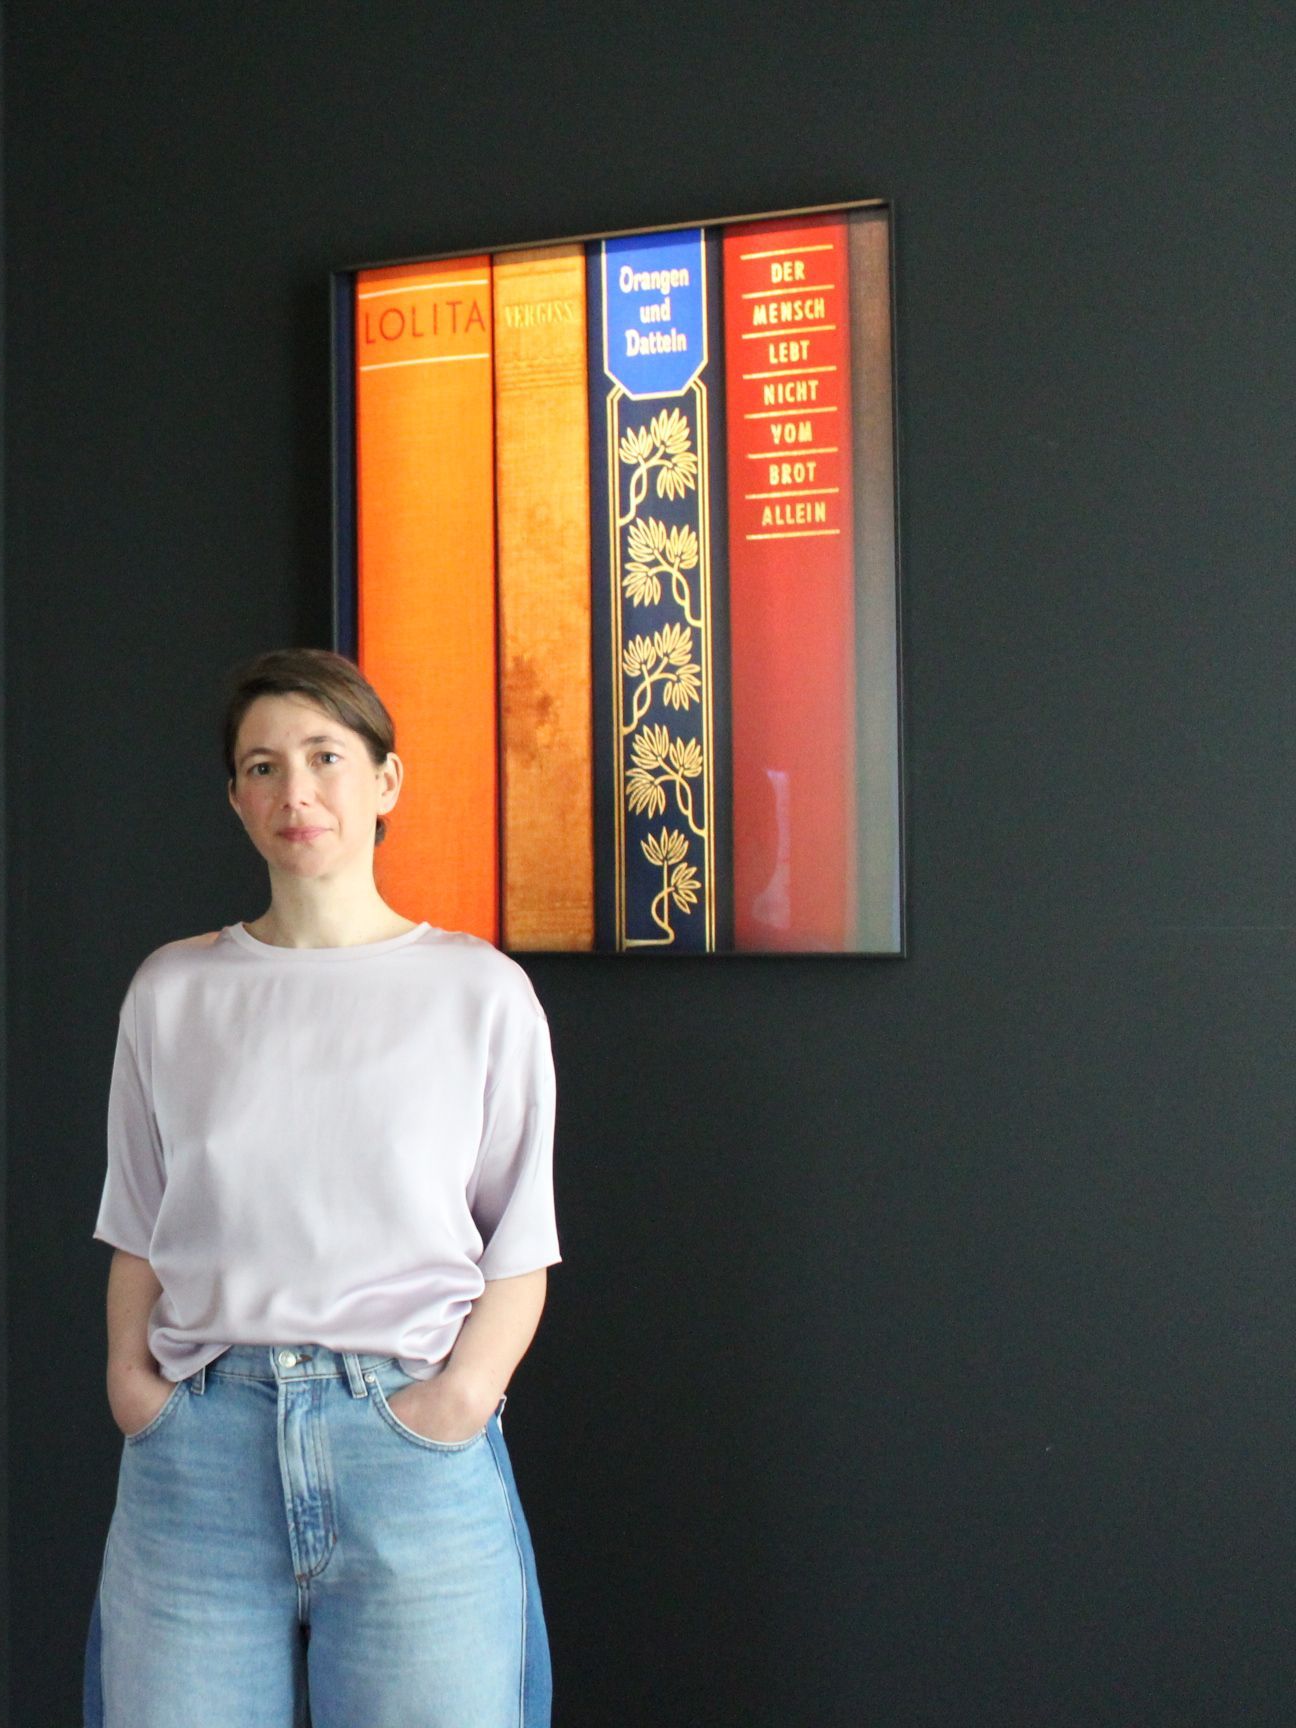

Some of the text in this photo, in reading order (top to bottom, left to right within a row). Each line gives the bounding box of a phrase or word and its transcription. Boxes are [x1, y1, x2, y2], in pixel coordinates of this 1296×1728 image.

[619, 265, 690, 295] Orangen
[770, 260, 805, 284] DER
[365, 300, 486, 345] LOLITA
[503, 300, 575, 328] VERGISS
[639, 297, 671, 324] und
[752, 297, 825, 326] MENSCH
[624, 328, 687, 357] Datteln
[768, 340, 810, 365] LEBT
[763, 380, 819, 406] NICHT
[770, 421, 813, 445] VOM
[768, 462, 817, 486] BROT
[761, 501, 827, 526] ALLEIN
